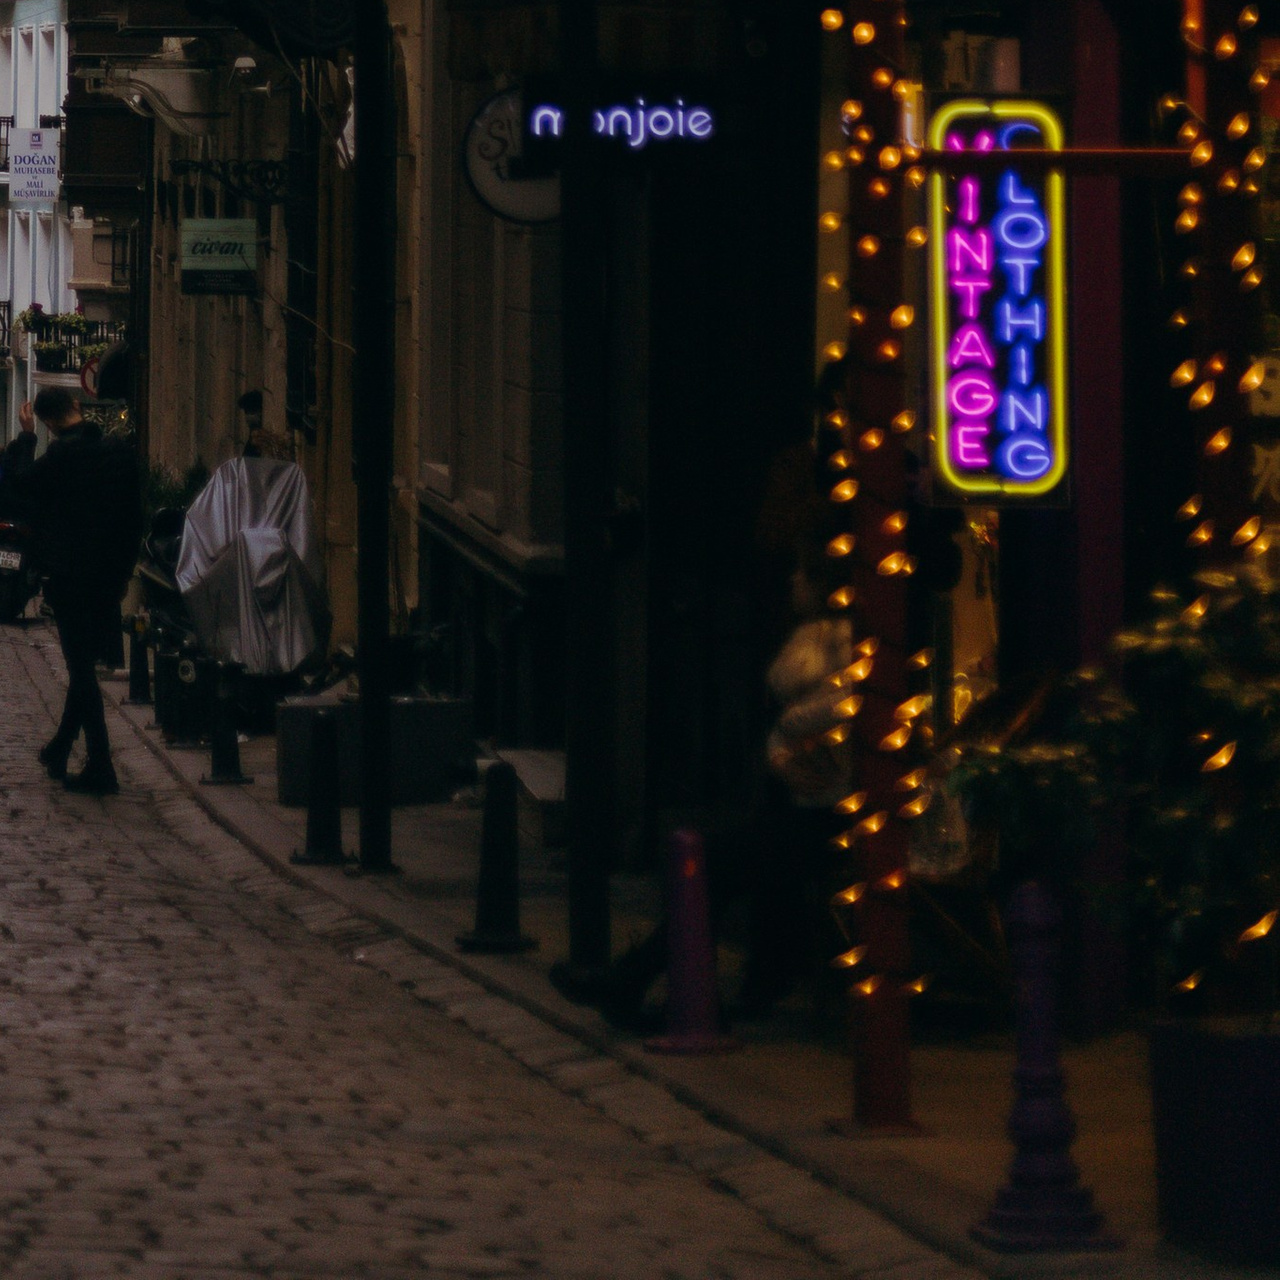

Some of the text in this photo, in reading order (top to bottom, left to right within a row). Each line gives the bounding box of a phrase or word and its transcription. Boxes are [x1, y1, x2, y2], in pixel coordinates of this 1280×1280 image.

[14, 152, 57, 165] DOĞAN
[14, 167, 56, 175] MUHASEBE
[26, 180, 43, 188] MALİ
[14, 188, 56, 199] MÜŞAVİRLİK
[1000, 124, 1051, 476] CLOTHING
